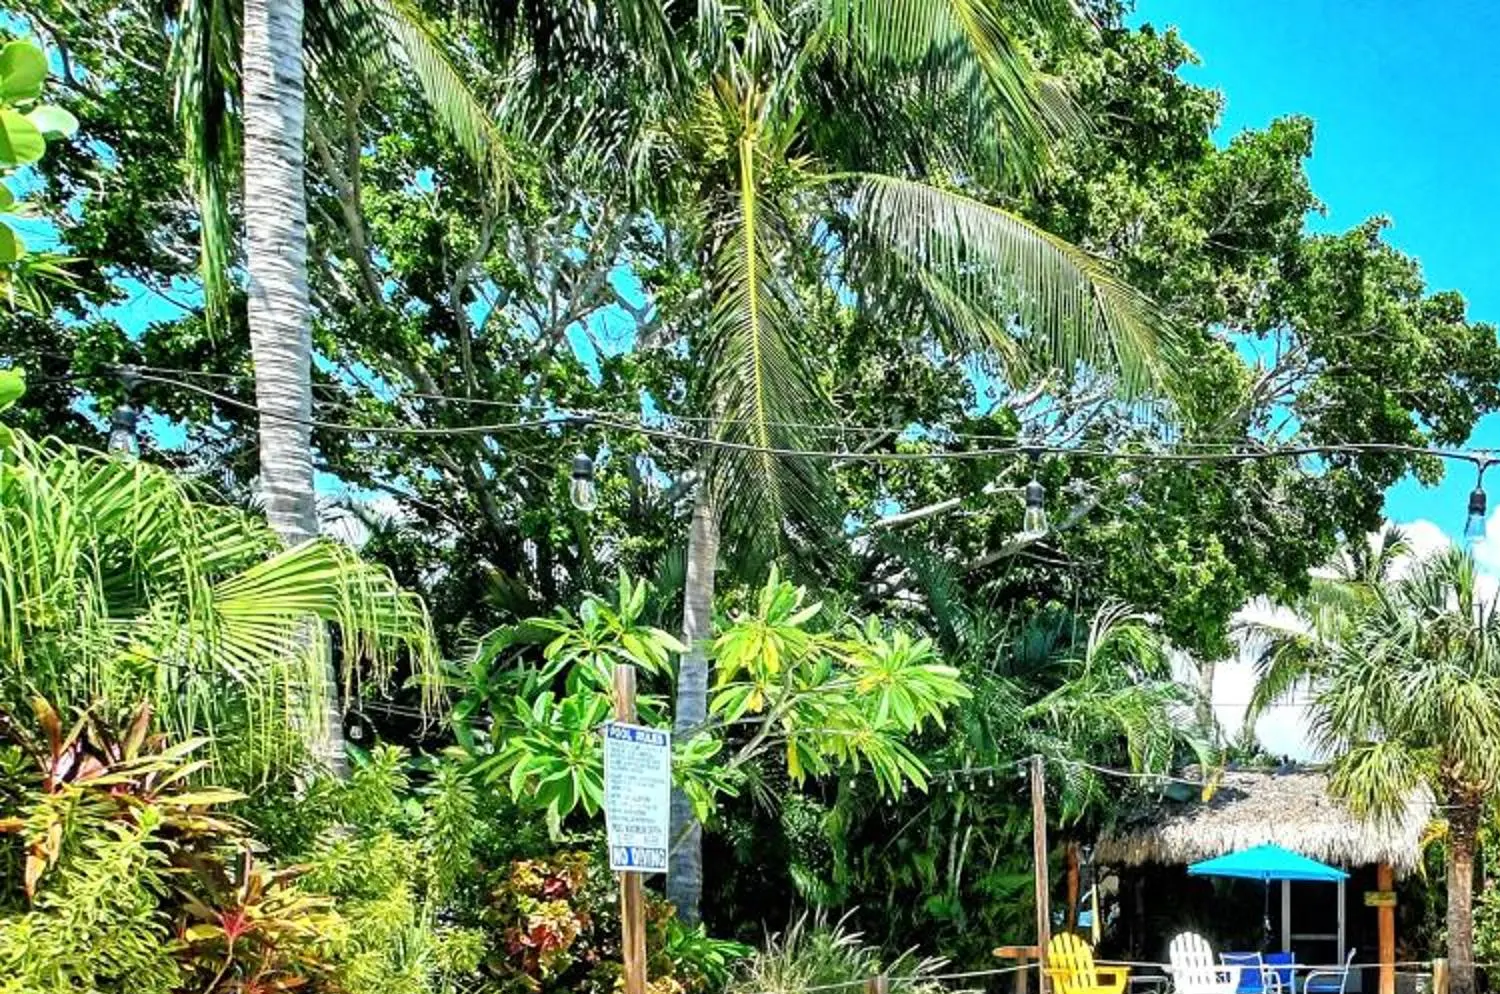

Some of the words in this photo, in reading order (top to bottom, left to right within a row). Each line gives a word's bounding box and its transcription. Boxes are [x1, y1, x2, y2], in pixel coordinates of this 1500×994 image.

[609, 725, 630, 740] POOL
[634, 730, 663, 745] RULES
[612, 847, 629, 866] NO
